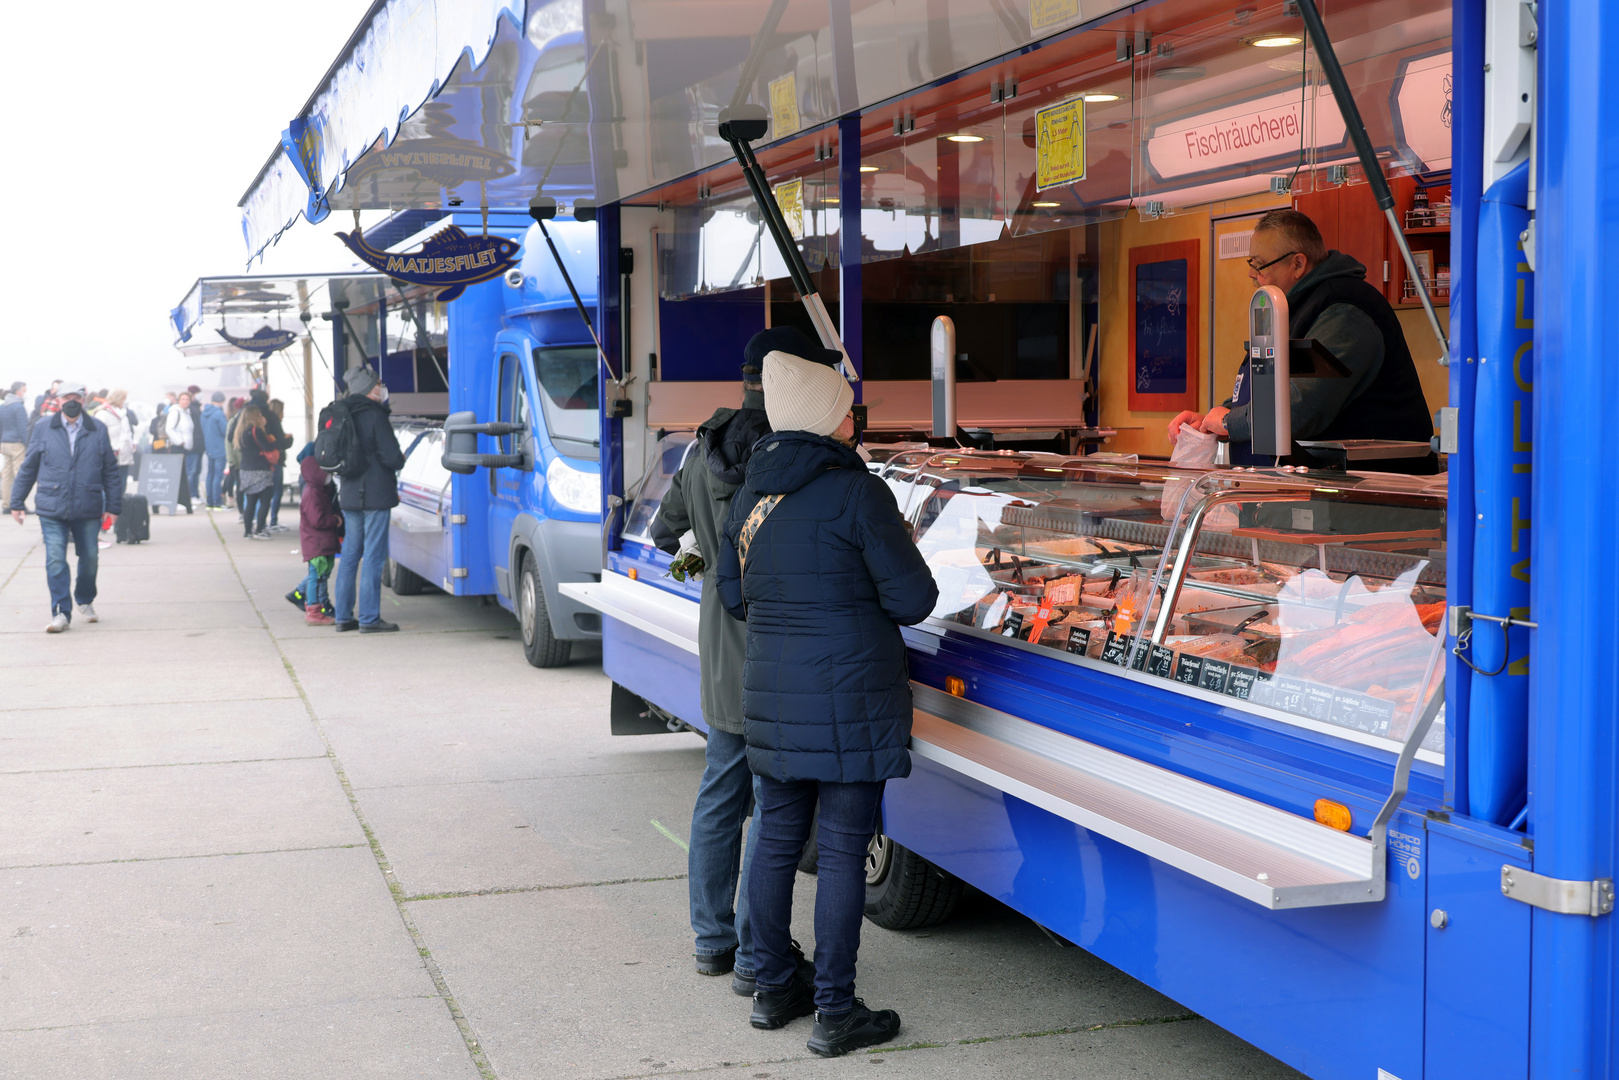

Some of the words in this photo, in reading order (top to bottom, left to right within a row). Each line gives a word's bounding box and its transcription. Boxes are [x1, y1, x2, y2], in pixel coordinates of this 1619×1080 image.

[1184, 105, 1300, 159] Fischräucherei
[386, 248, 497, 274] MATJESFILET
[1037, 608, 1050, 619] NEU
[1389, 829, 1420, 845] BORCO
[1389, 838, 1420, 855] HÖHNS
